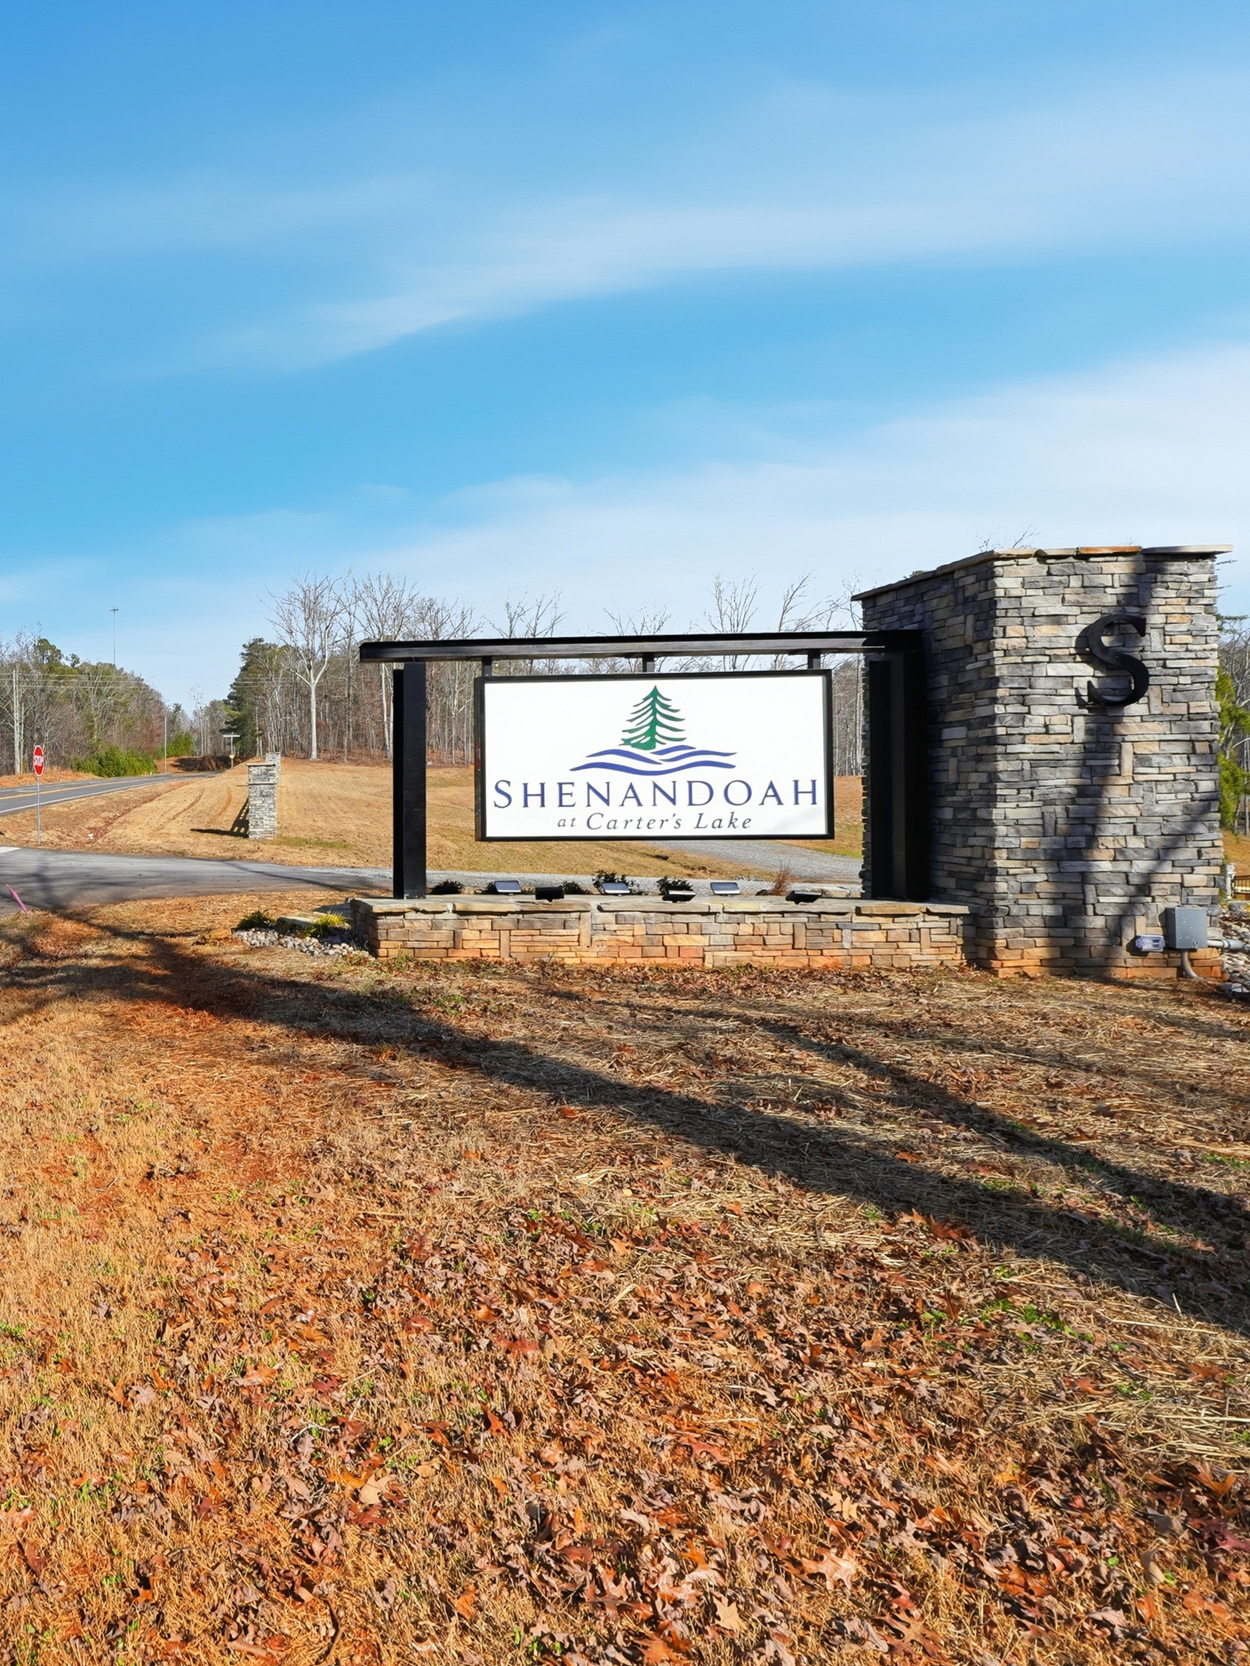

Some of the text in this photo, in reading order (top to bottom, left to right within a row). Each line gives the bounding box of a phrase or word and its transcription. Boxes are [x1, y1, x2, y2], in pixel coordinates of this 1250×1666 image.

[1087, 614, 1149, 706] S
[493, 779, 818, 808] SHENANDOAH
[557, 812, 752, 830] at Carter's Lake
